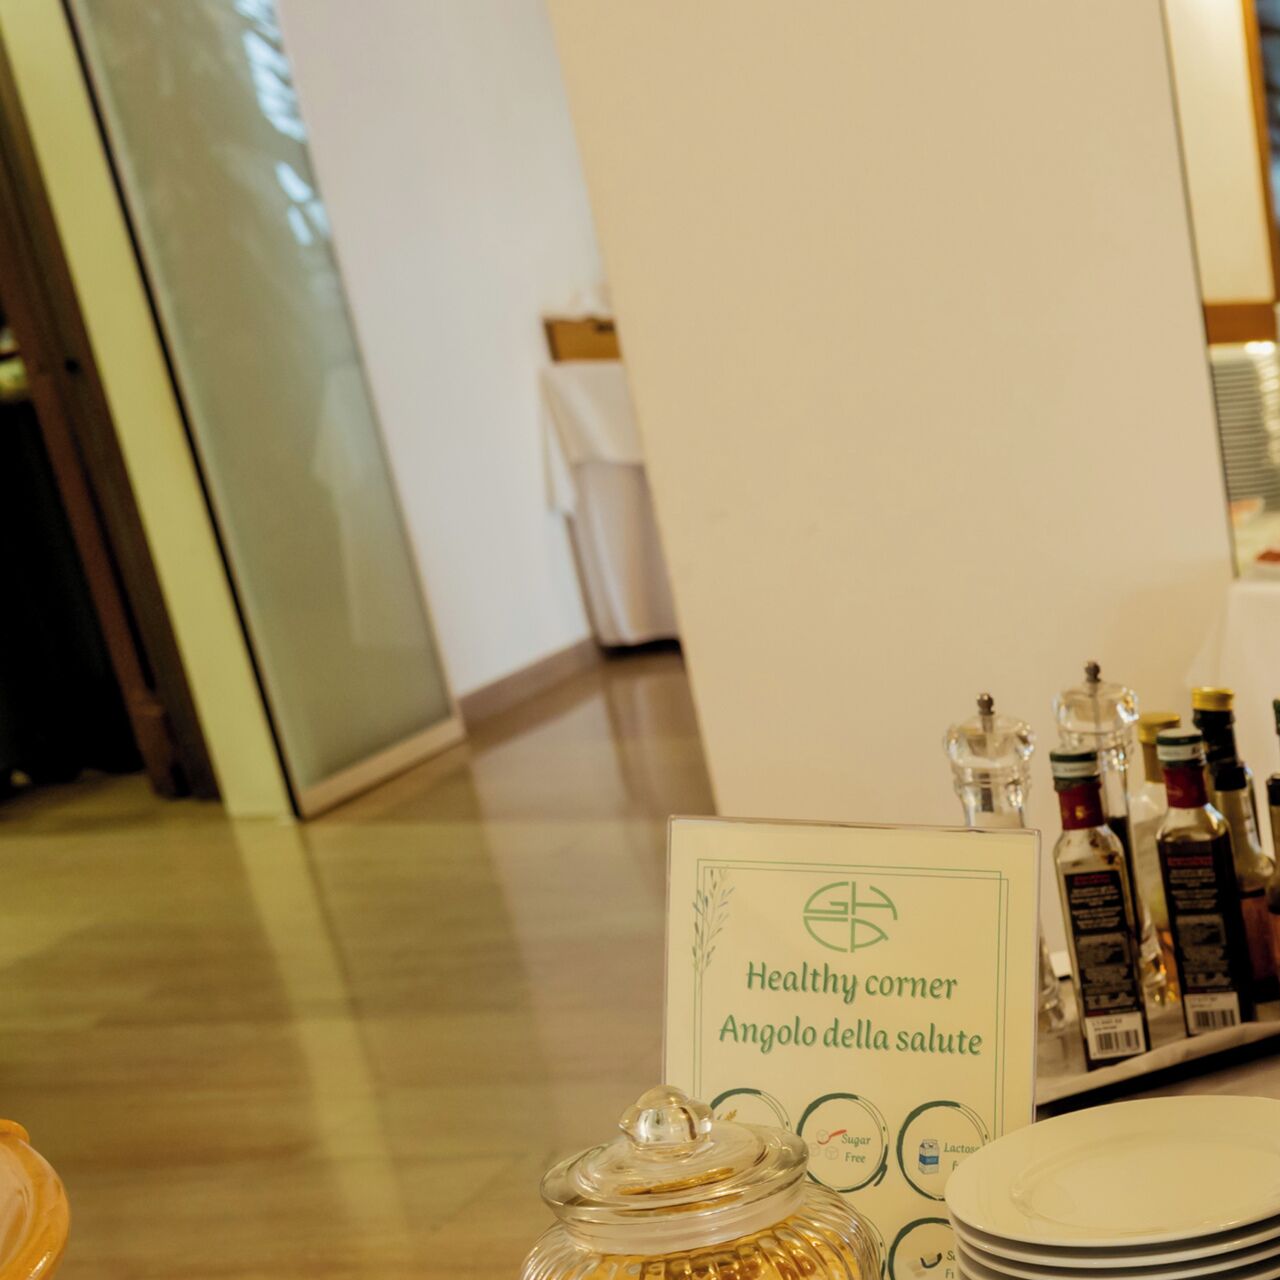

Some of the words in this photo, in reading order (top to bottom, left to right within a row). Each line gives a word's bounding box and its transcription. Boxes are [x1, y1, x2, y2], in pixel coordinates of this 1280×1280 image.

[746, 961, 858, 1005] Healthy
[864, 974, 958, 1000] corner
[718, 1013, 818, 1055] Angolo
[822, 1017, 890, 1051] della
[895, 1022, 983, 1056] salute
[841, 1133, 872, 1148] Sugar
[844, 1151, 867, 1164] Free
